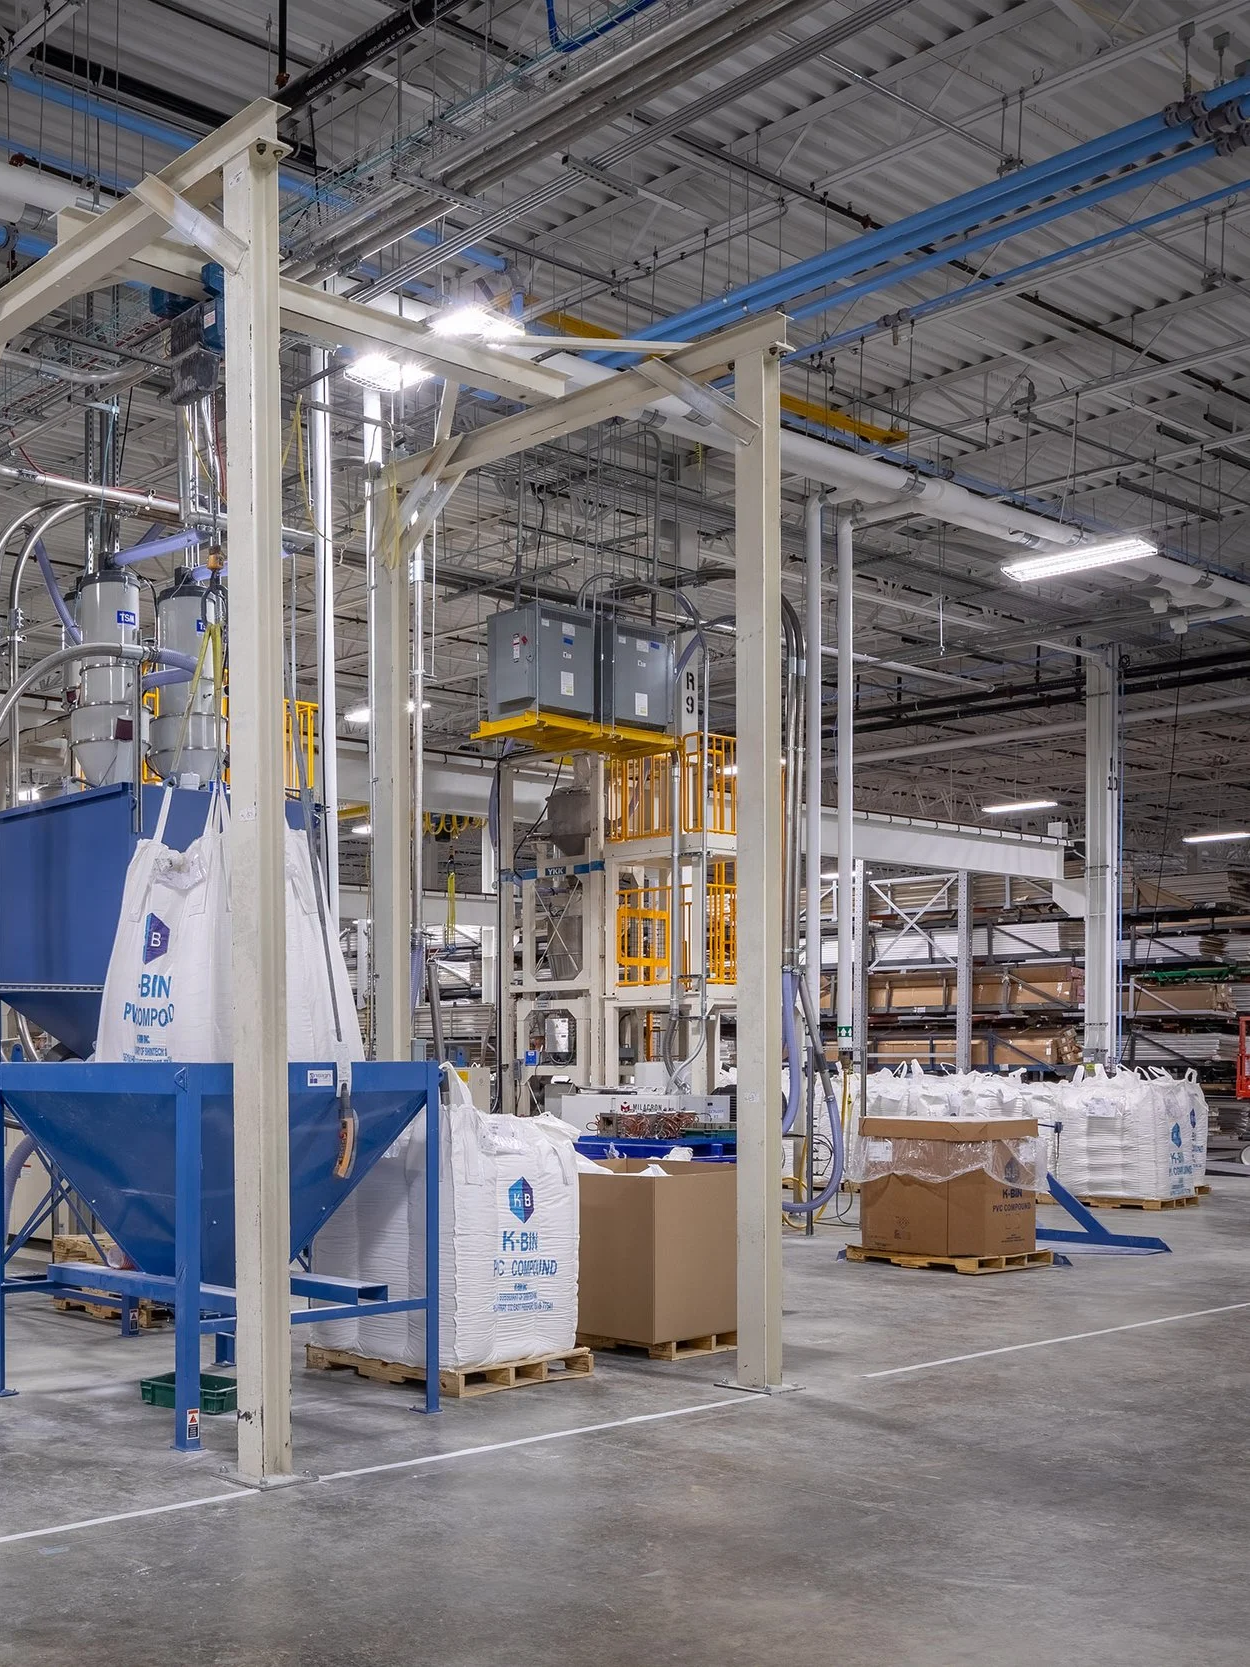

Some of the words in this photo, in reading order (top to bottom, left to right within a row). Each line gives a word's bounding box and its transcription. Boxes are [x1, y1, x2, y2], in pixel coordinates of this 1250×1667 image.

[686, 672, 695, 691] R
[685, 696, 695, 714] 9
[547, 867, 565, 876] YKK
[633, 1103, 662, 1112] MILACRON
[1002, 1188, 1023, 1199] K-BIN
